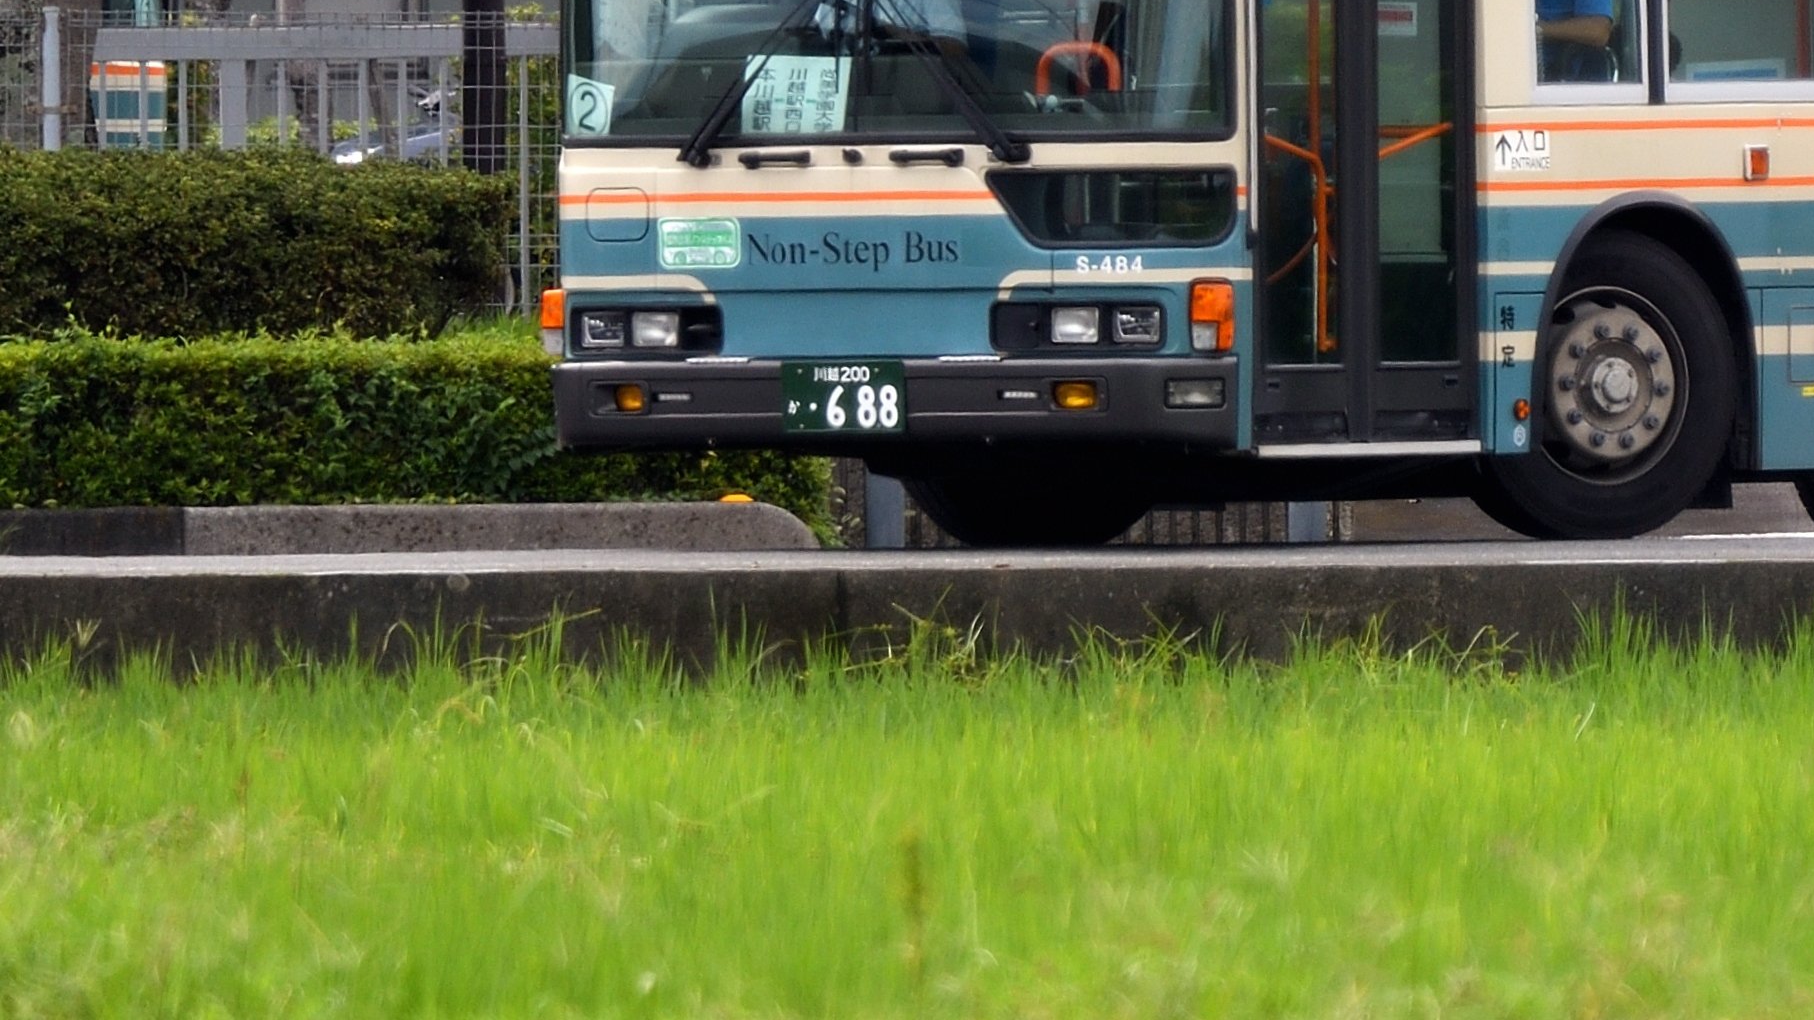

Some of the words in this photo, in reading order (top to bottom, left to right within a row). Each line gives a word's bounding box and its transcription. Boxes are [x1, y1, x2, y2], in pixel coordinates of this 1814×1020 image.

[1515, 130, 1546, 152] 入口
[1511, 156, 1551, 170] ENTRANCE
[747, 231, 890, 272] Non-Step
[904, 230, 960, 263] Bus
[1076, 255, 1143, 274] S-484
[1501, 305, 1515, 368] 特定
